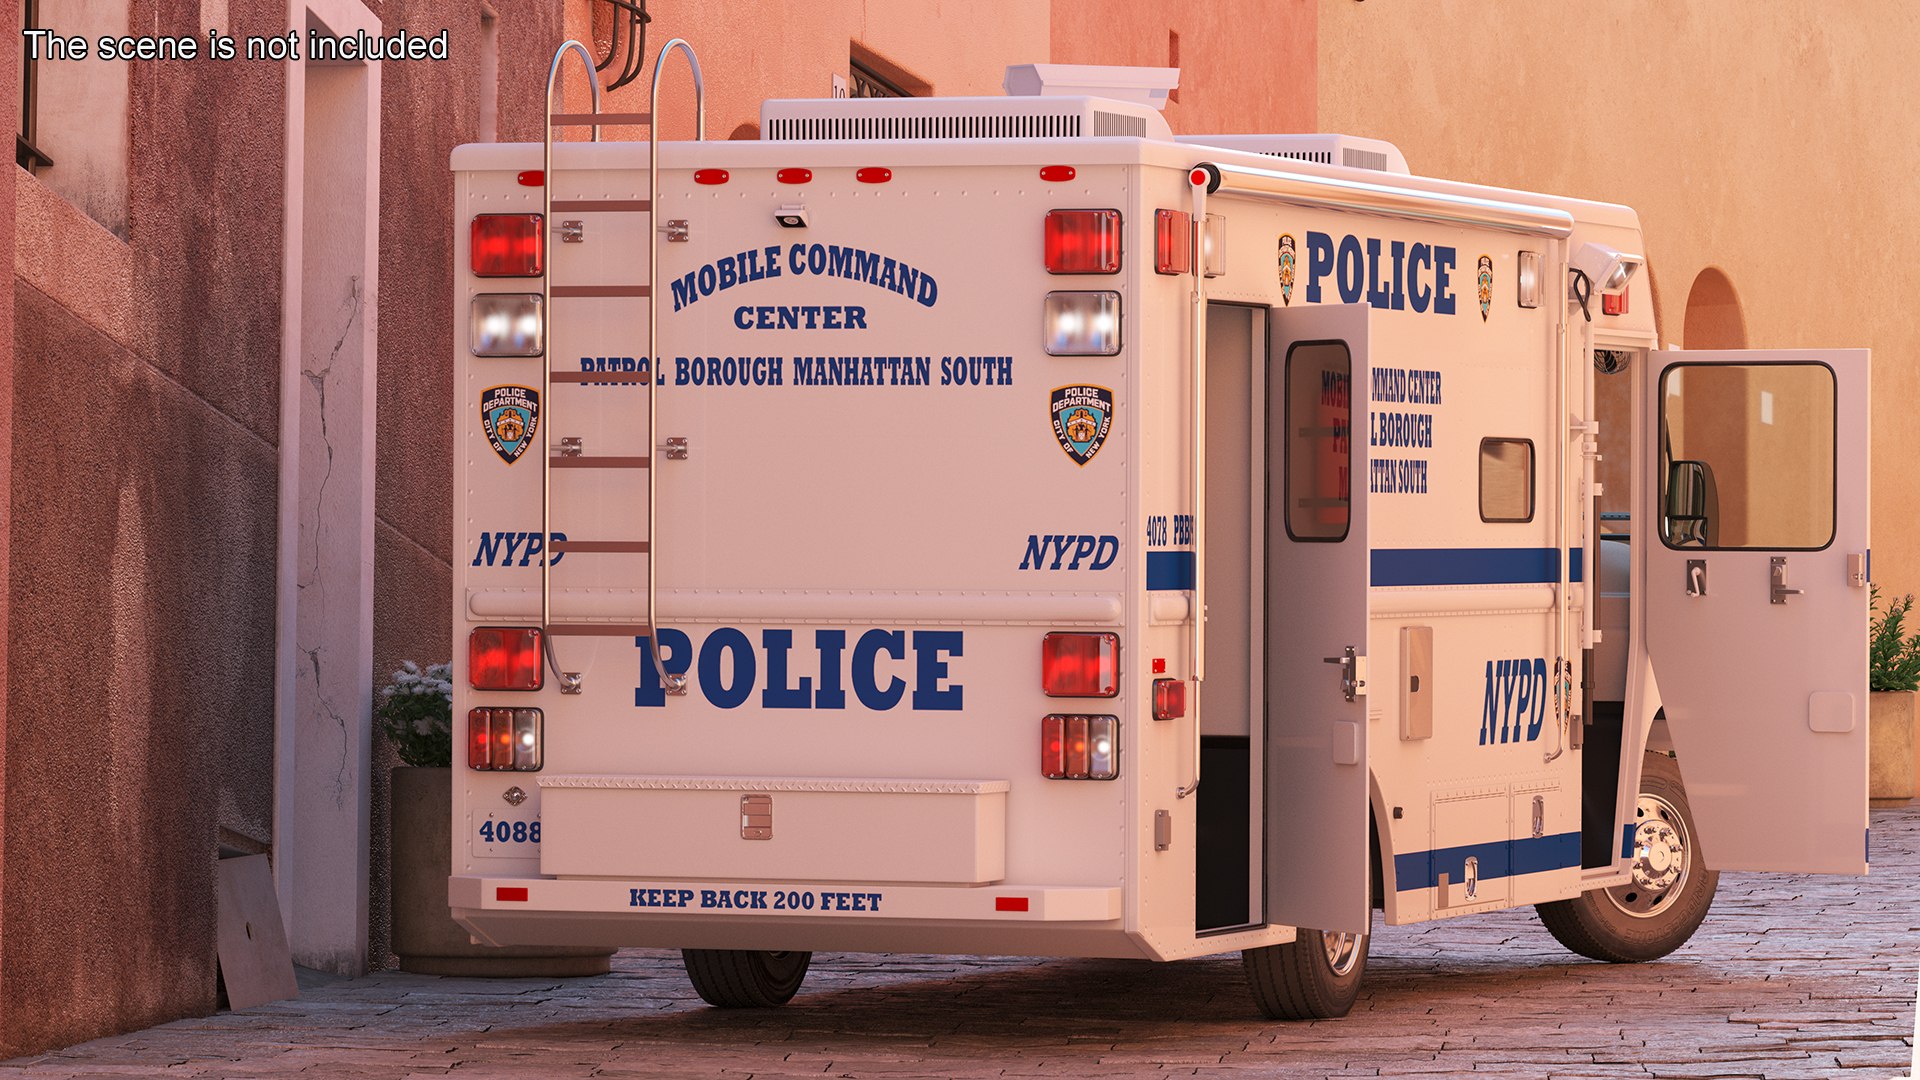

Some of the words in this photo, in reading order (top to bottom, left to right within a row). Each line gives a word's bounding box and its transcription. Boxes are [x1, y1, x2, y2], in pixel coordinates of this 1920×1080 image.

[671, 245, 781, 312] MOBILE
[789, 243, 938, 308] COMMAND
[1306, 231, 1456, 315] POLICE
[734, 306, 867, 329] CENTER
[675, 356, 783, 386] BOROUGH
[793, 356, 931, 386] MANHATTAN
[941, 356, 1013, 386] SOUTH
[1408, 369, 1442, 405] CENTER
[483, 397, 538, 413] DEPARTMENT
[494, 388, 526, 399] POLICE
[1052, 397, 1111, 413] DEPARTMENT
[1065, 387, 1099, 398] POLICE
[484, 419, 496, 440] CITY
[493, 441, 503, 452] OF
[514, 440, 528, 457] NEW
[526, 416, 538, 438] YORK
[1053, 420, 1066, 440] CITY
[1063, 442, 1074, 453] OF
[1085, 441, 1100, 459] NEW
[1098, 416, 1111, 439] YORK
[1379, 412, 1433, 448] BOROUGH
[1398, 459, 1427, 494] SOUTH
[1146, 515, 1168, 546] 4078
[1019, 535, 1119, 570] NYPD
[635, 627, 963, 711] POLICE
[1479, 658, 1547, 746] NYPD
[479, 820, 541, 843] 4088
[630, 888, 694, 907] KEEP
[701, 890, 767, 909] BACK
[774, 891, 815, 910] 200
[820, 892, 882, 911] FEET
